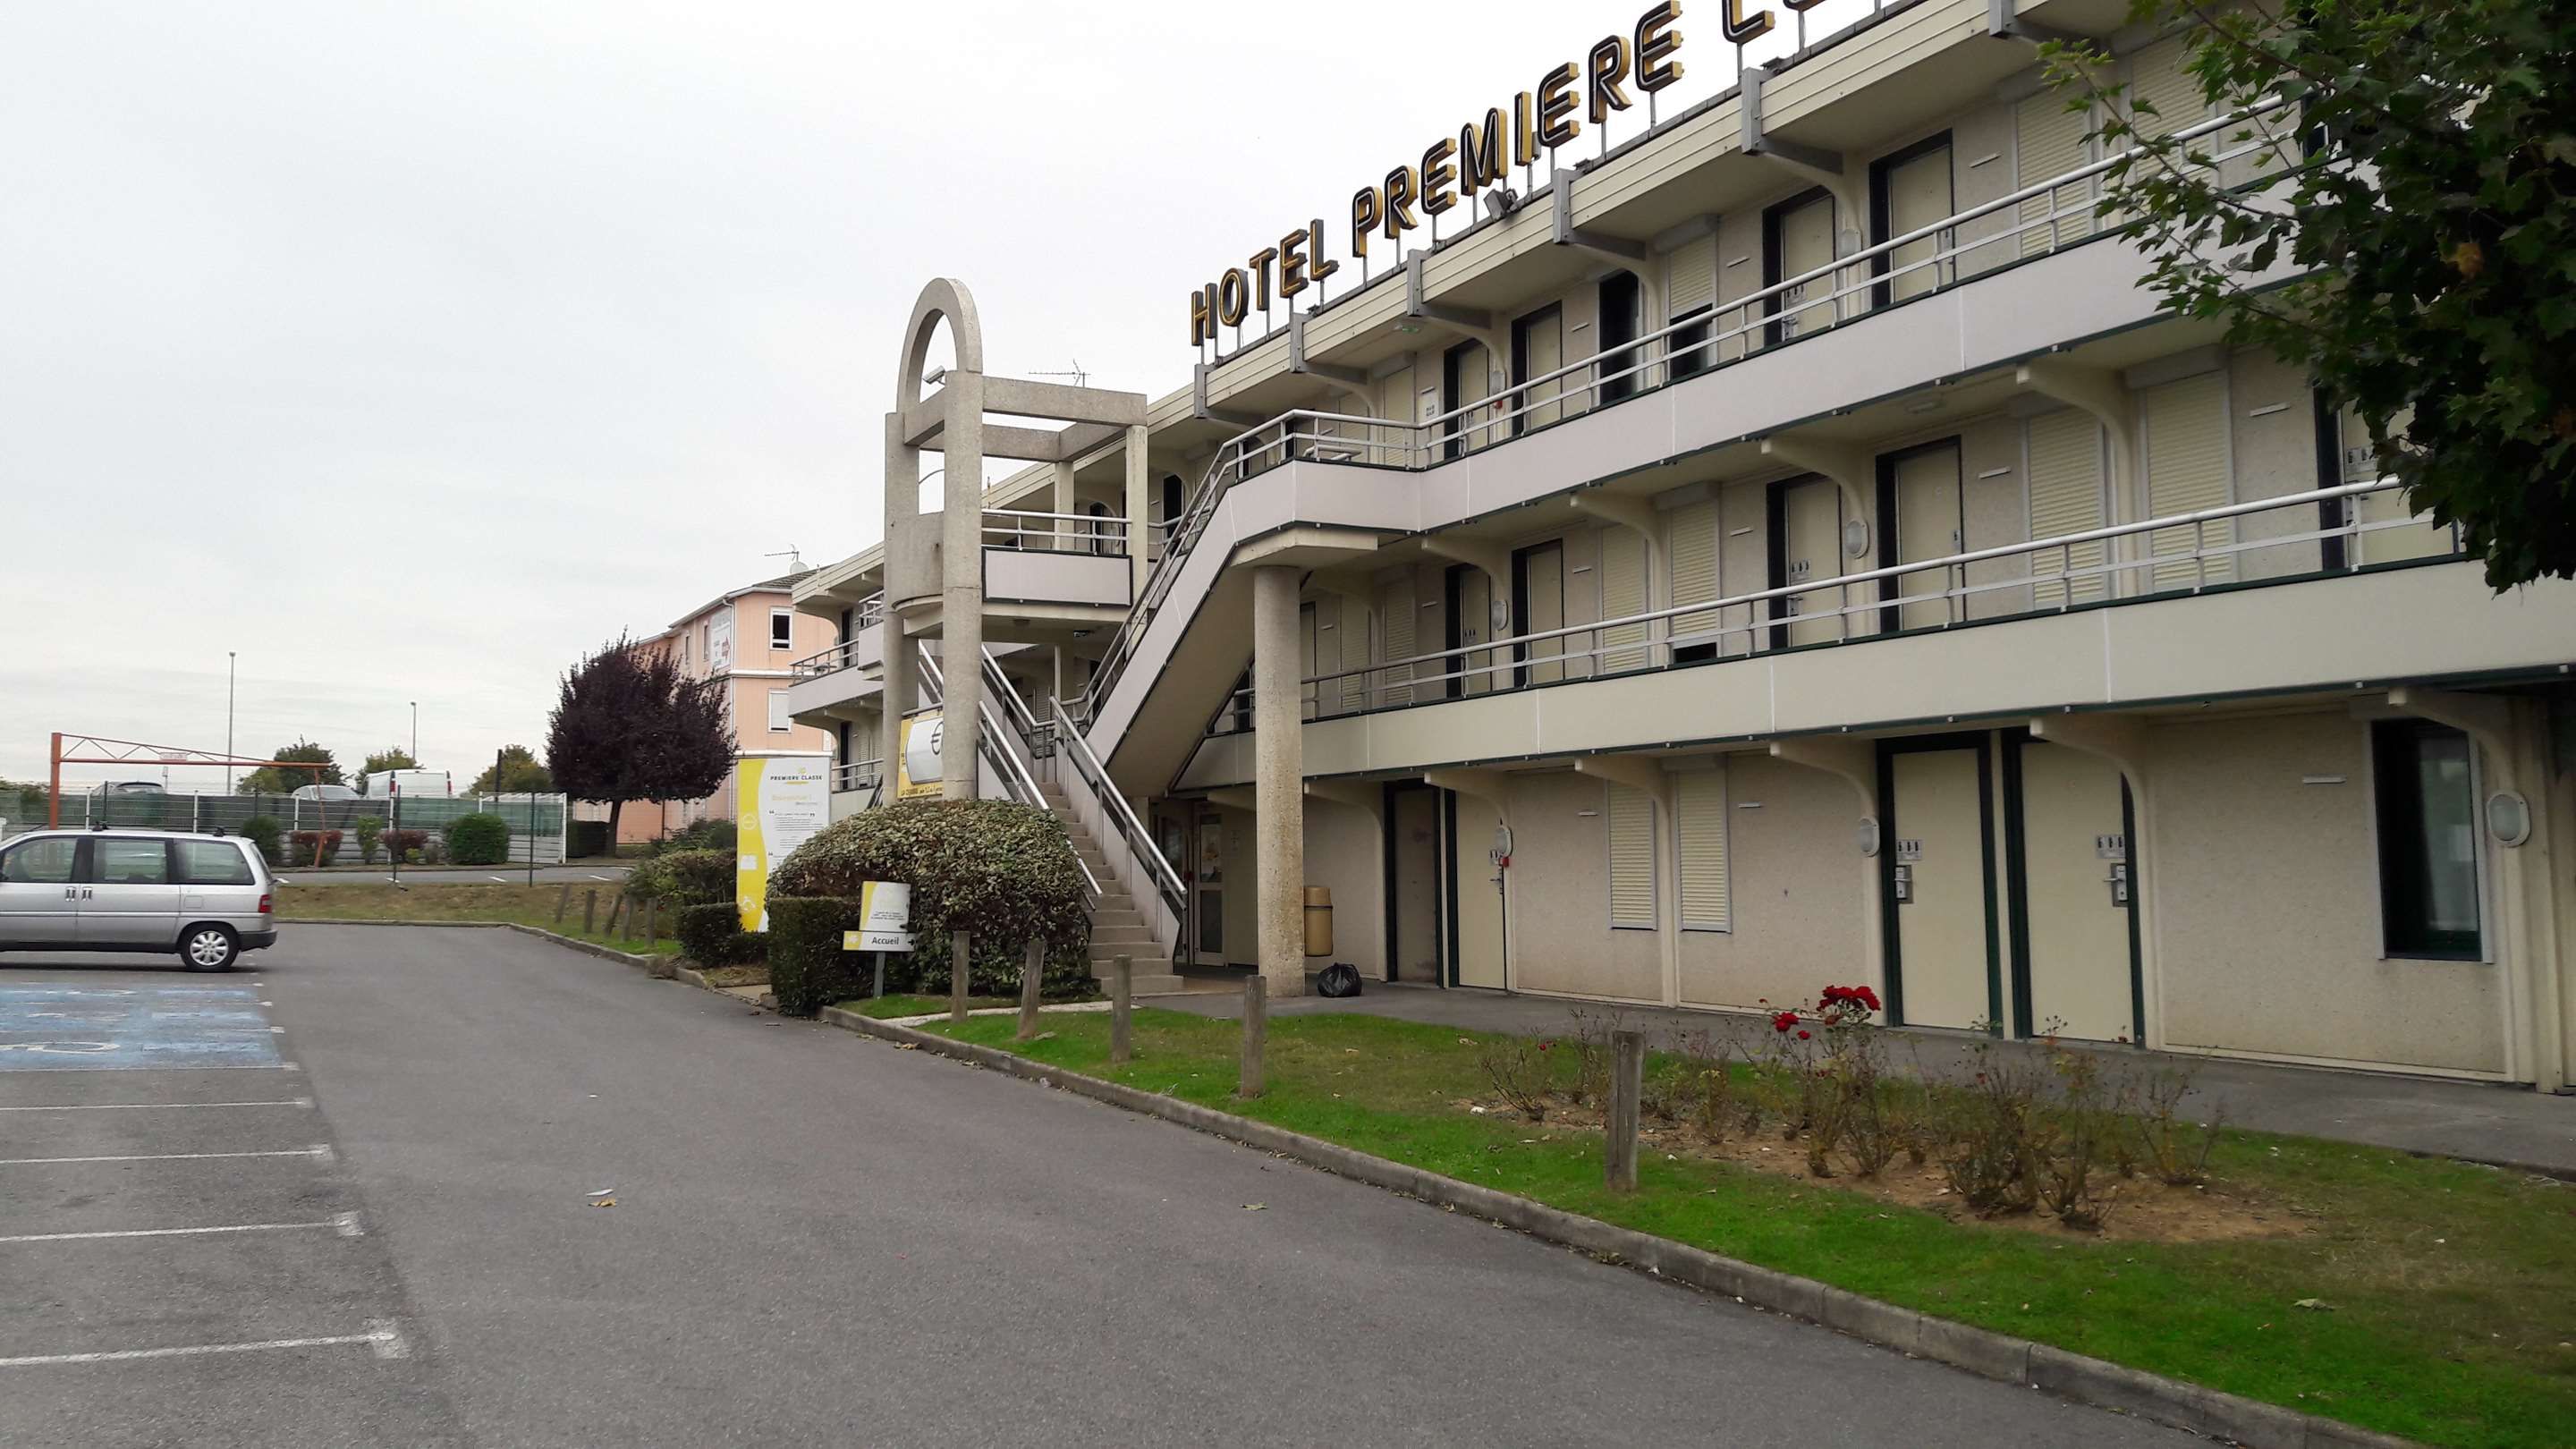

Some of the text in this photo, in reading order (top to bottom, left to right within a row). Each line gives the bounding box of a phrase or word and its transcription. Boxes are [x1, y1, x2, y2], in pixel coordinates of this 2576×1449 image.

[1191, 0, 1683, 346] HOTEL PREMIERE
[871, 936, 900, 945] Accueil
